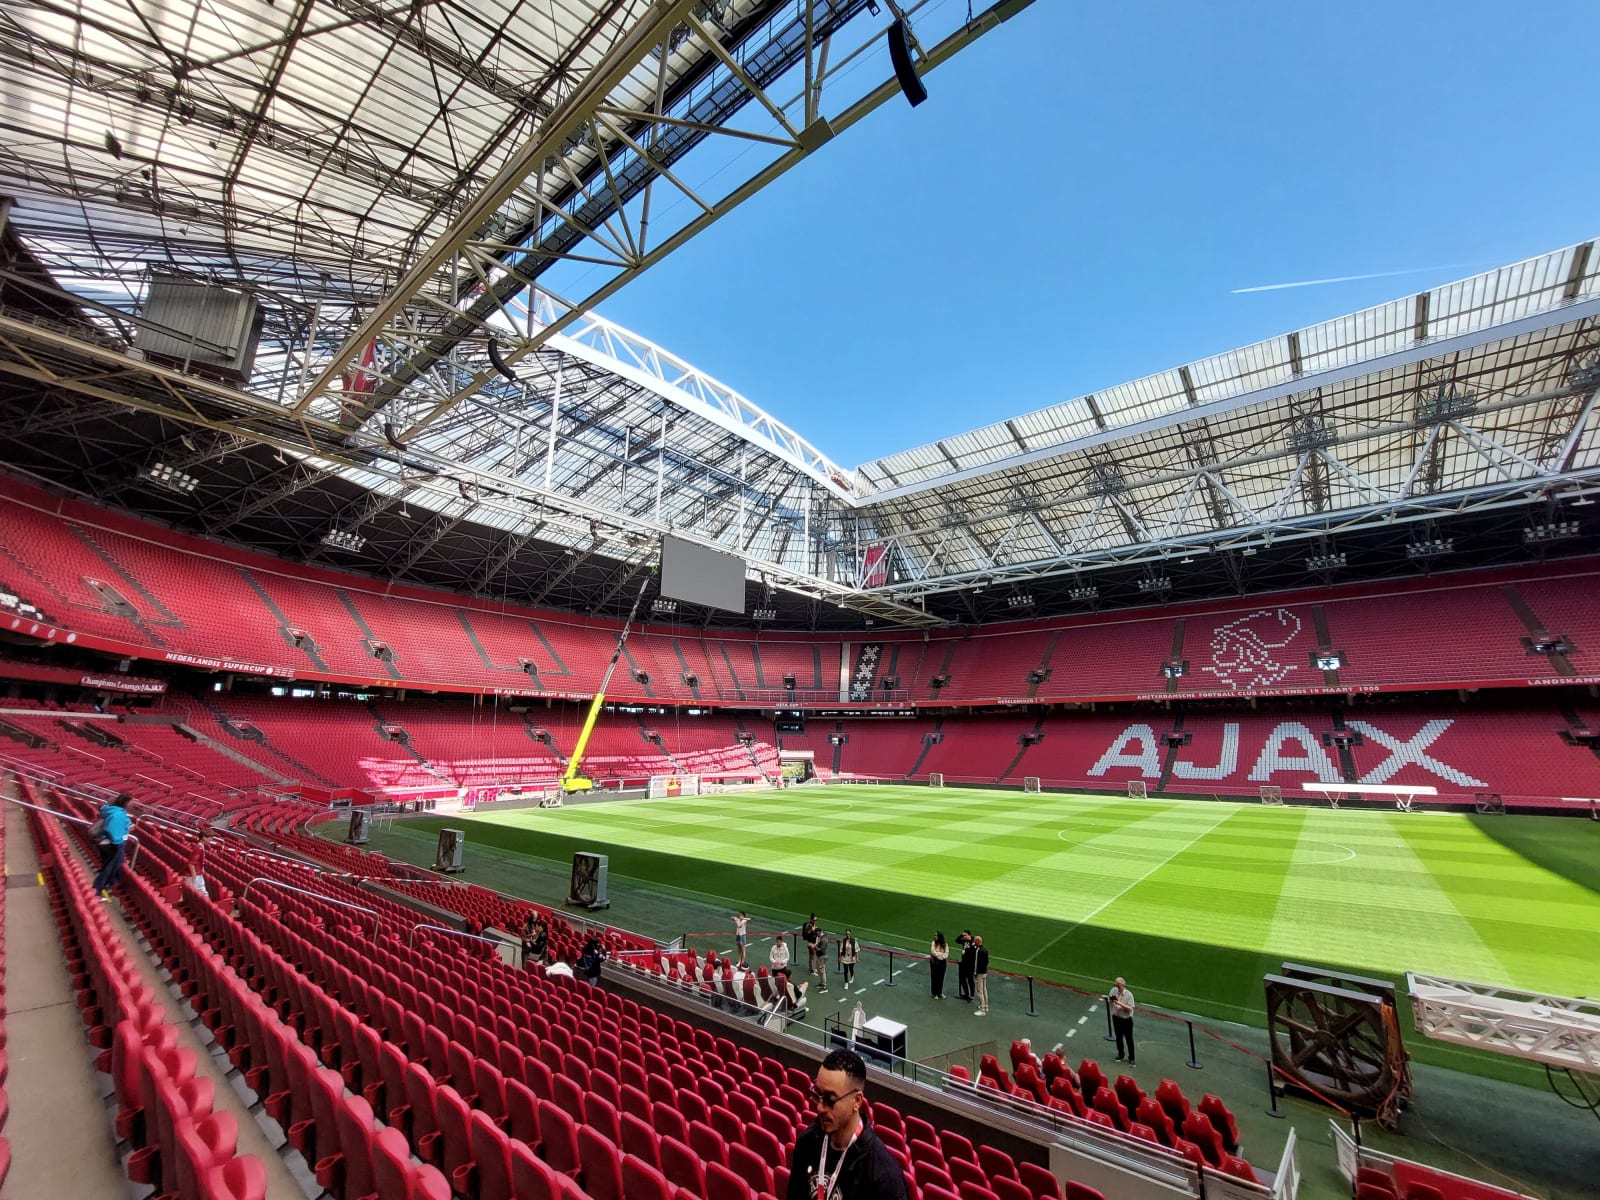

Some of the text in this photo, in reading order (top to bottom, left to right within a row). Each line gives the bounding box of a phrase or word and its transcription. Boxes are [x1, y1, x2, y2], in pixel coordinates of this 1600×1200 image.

[165, 652, 221, 667] NEDERLANDSE
[223, 662, 266, 673] SUPERCUP
[81, 676, 117, 687] Champions
[1259, 689, 1281, 697] AJAX
[1086, 719, 1489, 787] AJAX
